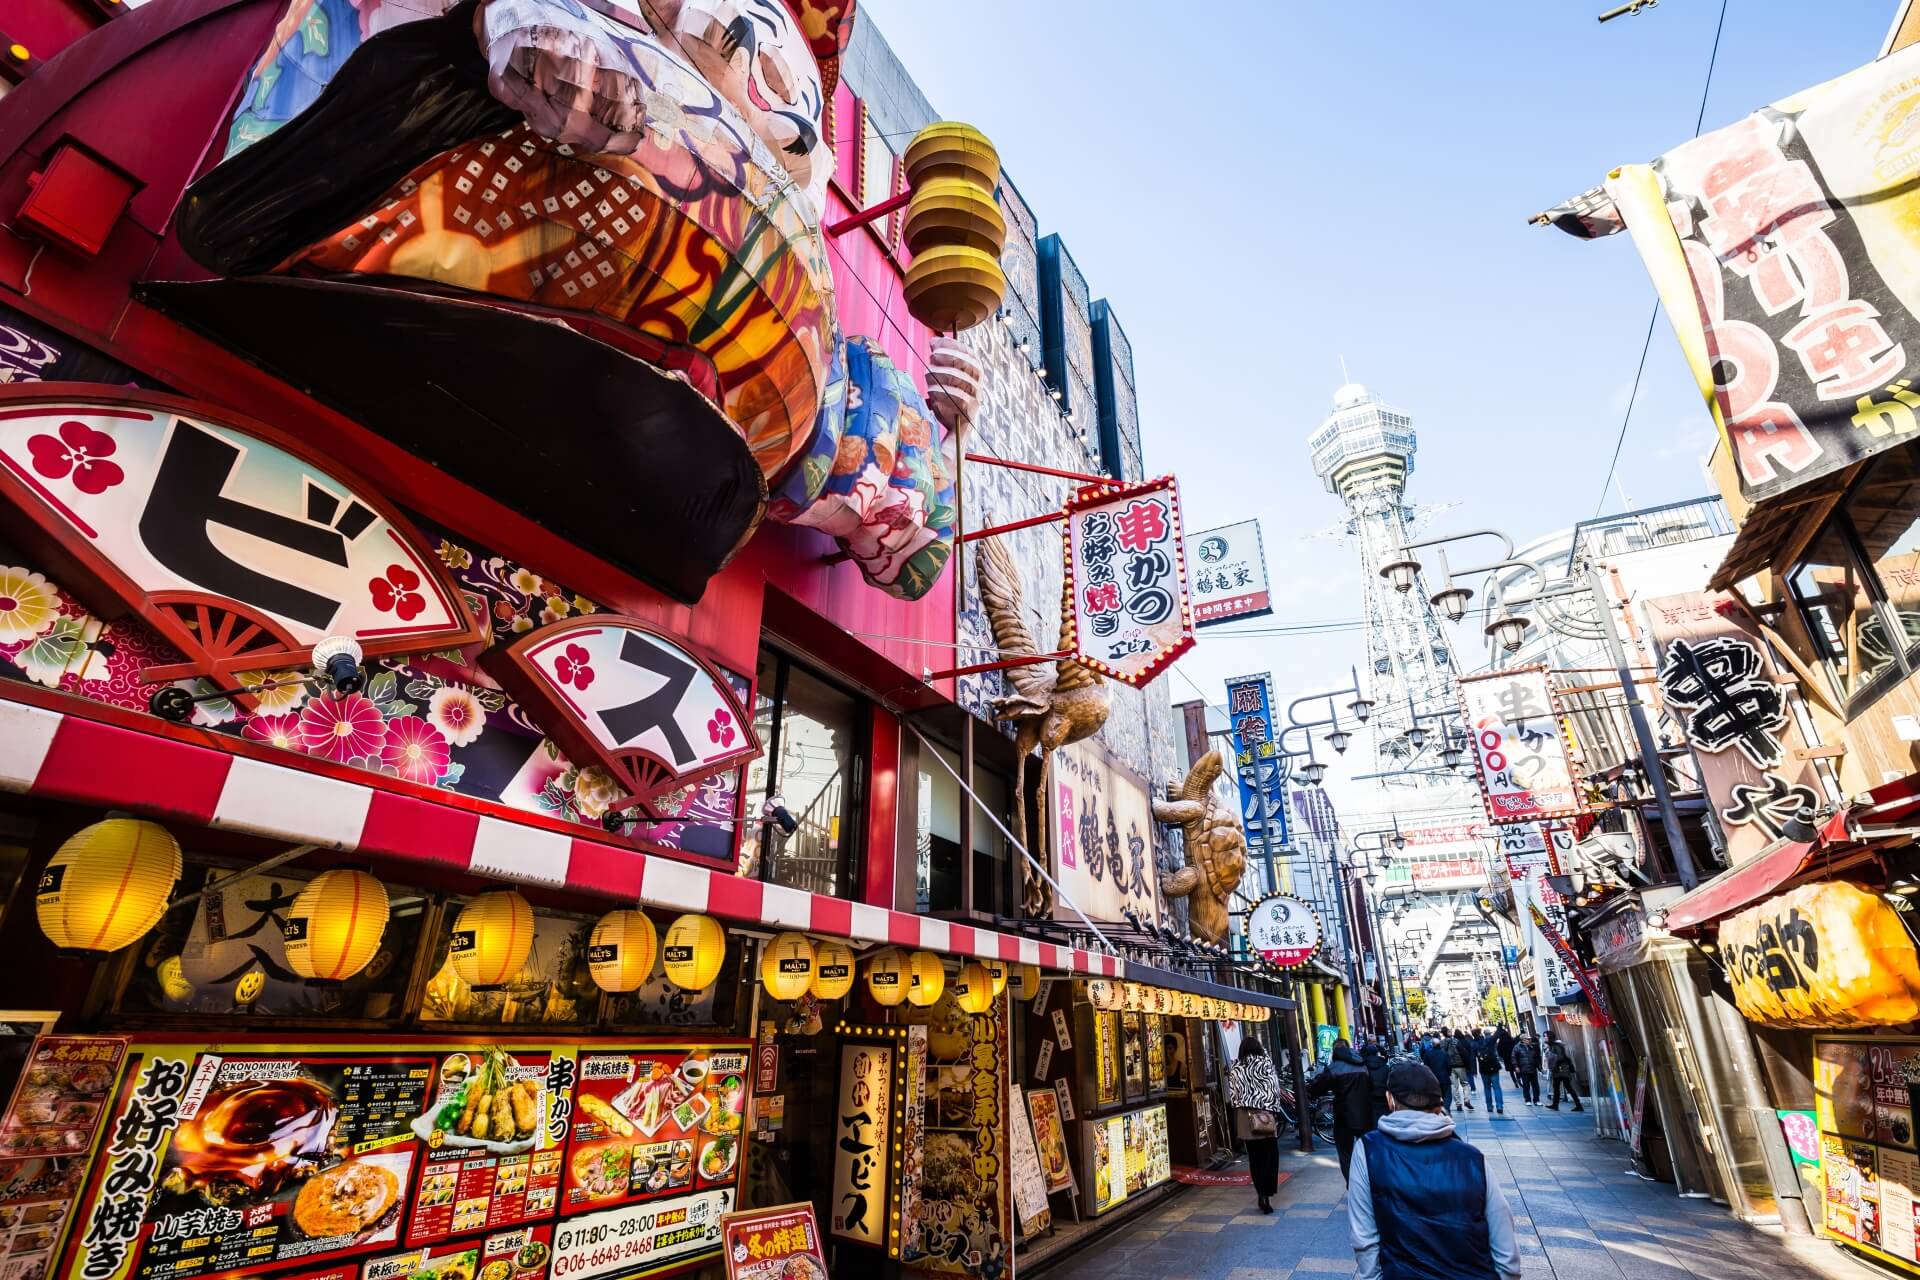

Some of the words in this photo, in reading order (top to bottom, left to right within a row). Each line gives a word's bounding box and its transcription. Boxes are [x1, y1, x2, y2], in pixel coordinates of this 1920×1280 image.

[138, 418, 379, 631] ビ
[1082, 512, 1122, 636] お好み焼き
[1115, 500, 1172, 624] 串かつ
[597, 630, 699, 767] ス
[1231, 684, 1268, 746] 麻雀
[1494, 681, 1556, 781] 串かつ
[1078, 794, 1152, 900] 鶴亀家
[784, 962, 807, 971] MALT'S
[823, 967, 846, 975] MALT'S
[180, 1059, 217, 1116] 全十三種
[222, 1062, 291, 1071] OKONOMIYAKI
[590, 1061, 630, 1075] 鉄板焼き
[545, 1057, 577, 1140] 串かつ
[82, 1060, 188, 1280] お好み焼き
[838, 1111, 876, 1236] エビス
[152, 1207, 243, 1242] 山芋焼き
[487, 1235, 523, 1252] ミニ鉄板
[657, 1209, 686, 1225] 年中無休
[748, 1224, 808, 1260] 冬の特選
[368, 1260, 416, 1280] 鉄板ロール
[568, 1236, 653, 1273] 06-6643-2468
